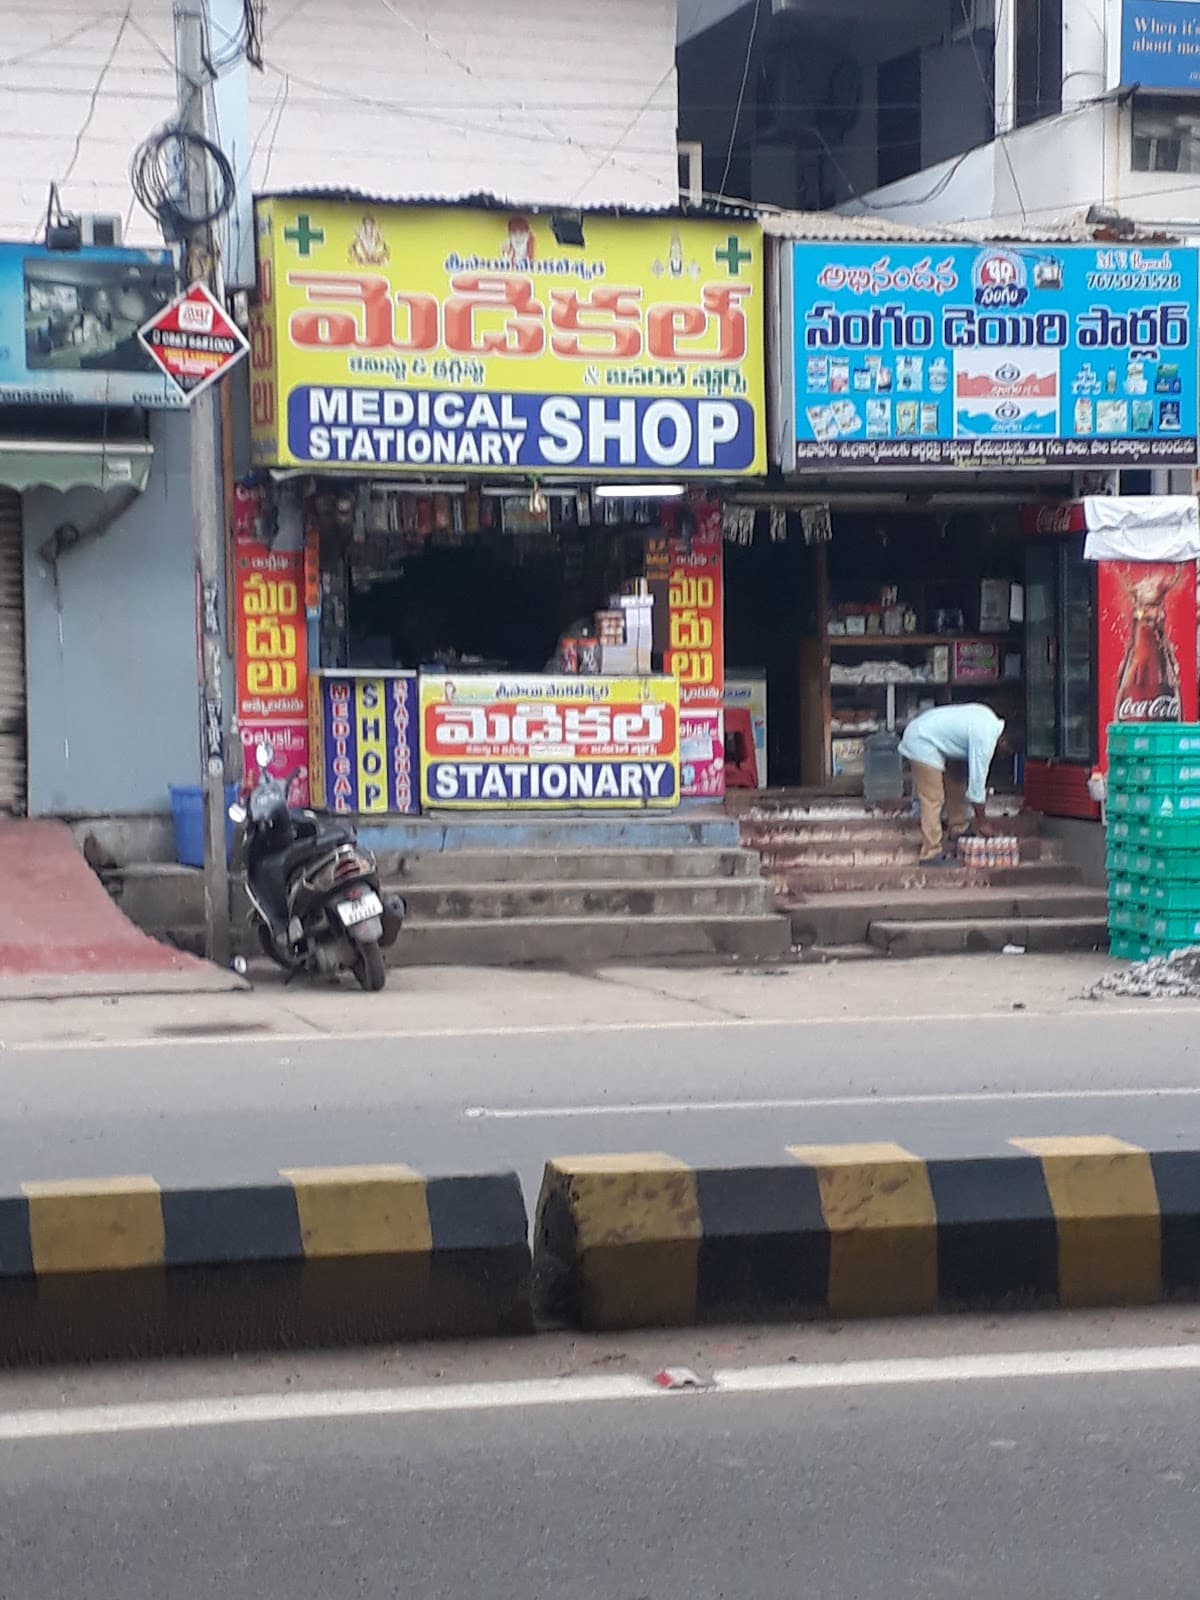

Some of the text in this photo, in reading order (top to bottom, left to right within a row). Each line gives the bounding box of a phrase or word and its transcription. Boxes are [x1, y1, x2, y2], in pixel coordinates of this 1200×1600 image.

[1132, 36, 1171, 54] about
[818, 256, 957, 295] అభినందన
[287, 270, 752, 362] మెడికల్
[807, 305, 1189, 360] సంగం డెయిరి పార్లర్
[309, 389, 528, 428] MEDICAL
[308, 427, 525, 465] STATIONARY
[539, 398, 740, 467] SHOP
[434, 702, 667, 746] మెడికల్
[1118, 695, 1179, 720] Coca-Cola
[331, 682, 352, 815] MEDICAL
[361, 682, 383, 809] SHOP
[435, 763, 668, 799] STATIONARY
